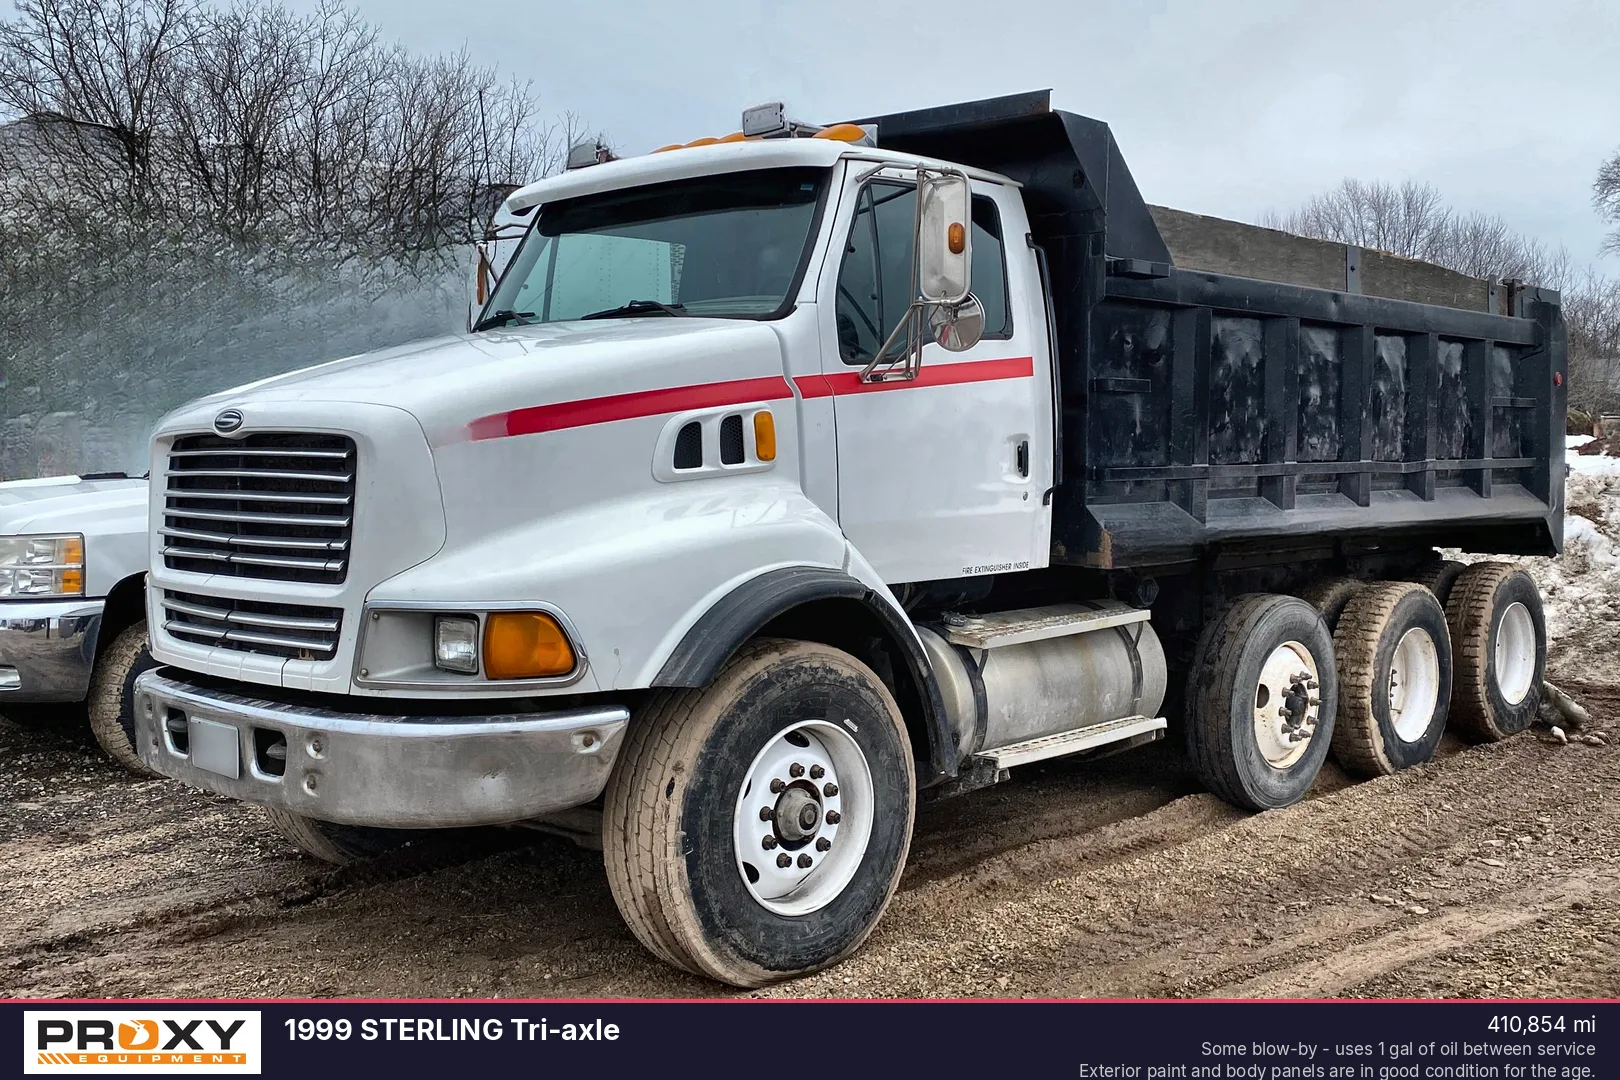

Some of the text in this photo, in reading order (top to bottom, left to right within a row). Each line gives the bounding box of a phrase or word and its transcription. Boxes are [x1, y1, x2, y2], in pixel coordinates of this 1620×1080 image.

[962, 561, 1029, 575] FIRE EXTINGUISHER INSIDE
